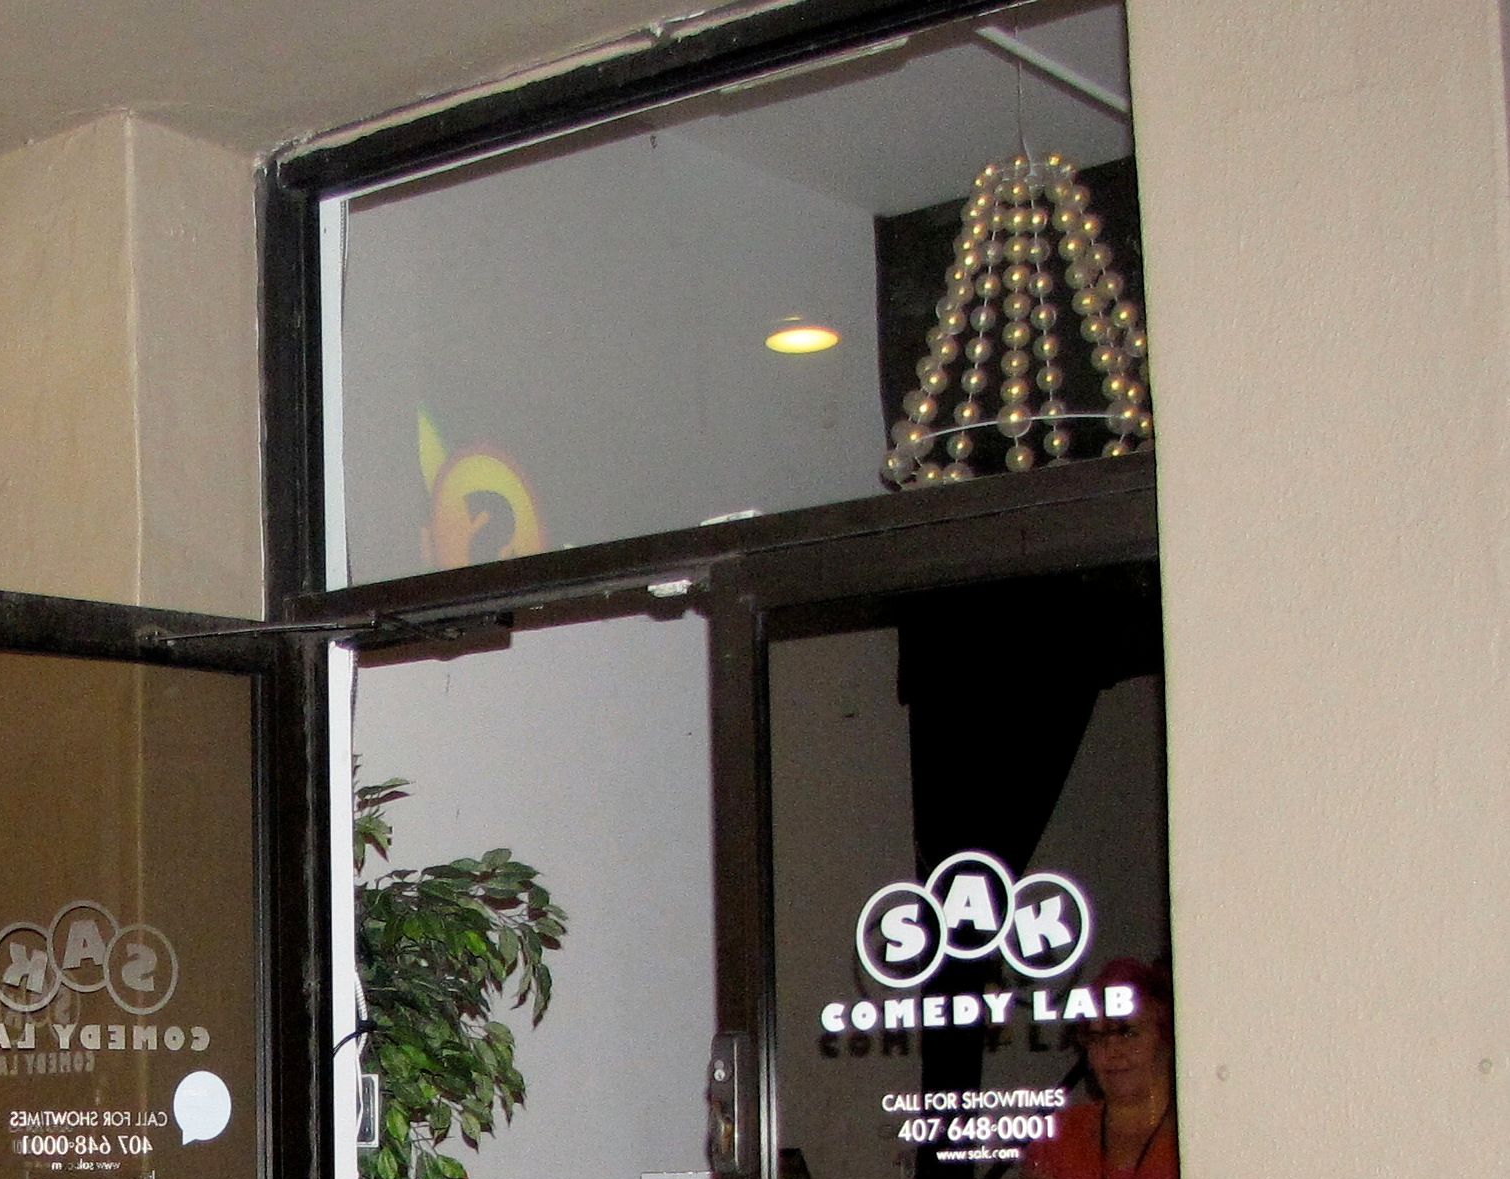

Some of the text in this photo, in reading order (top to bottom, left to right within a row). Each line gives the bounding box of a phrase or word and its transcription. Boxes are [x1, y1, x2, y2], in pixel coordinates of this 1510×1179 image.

[879, 873, 1076, 965] SAK
[820, 985, 1135, 1033] COMEDY LAB
[881, 1088, 1066, 1112] CALL FOR SHOWTIMES
[898, 1118, 940, 1142] 407
[936, 1145, 1019, 1160] wwwsak.com
